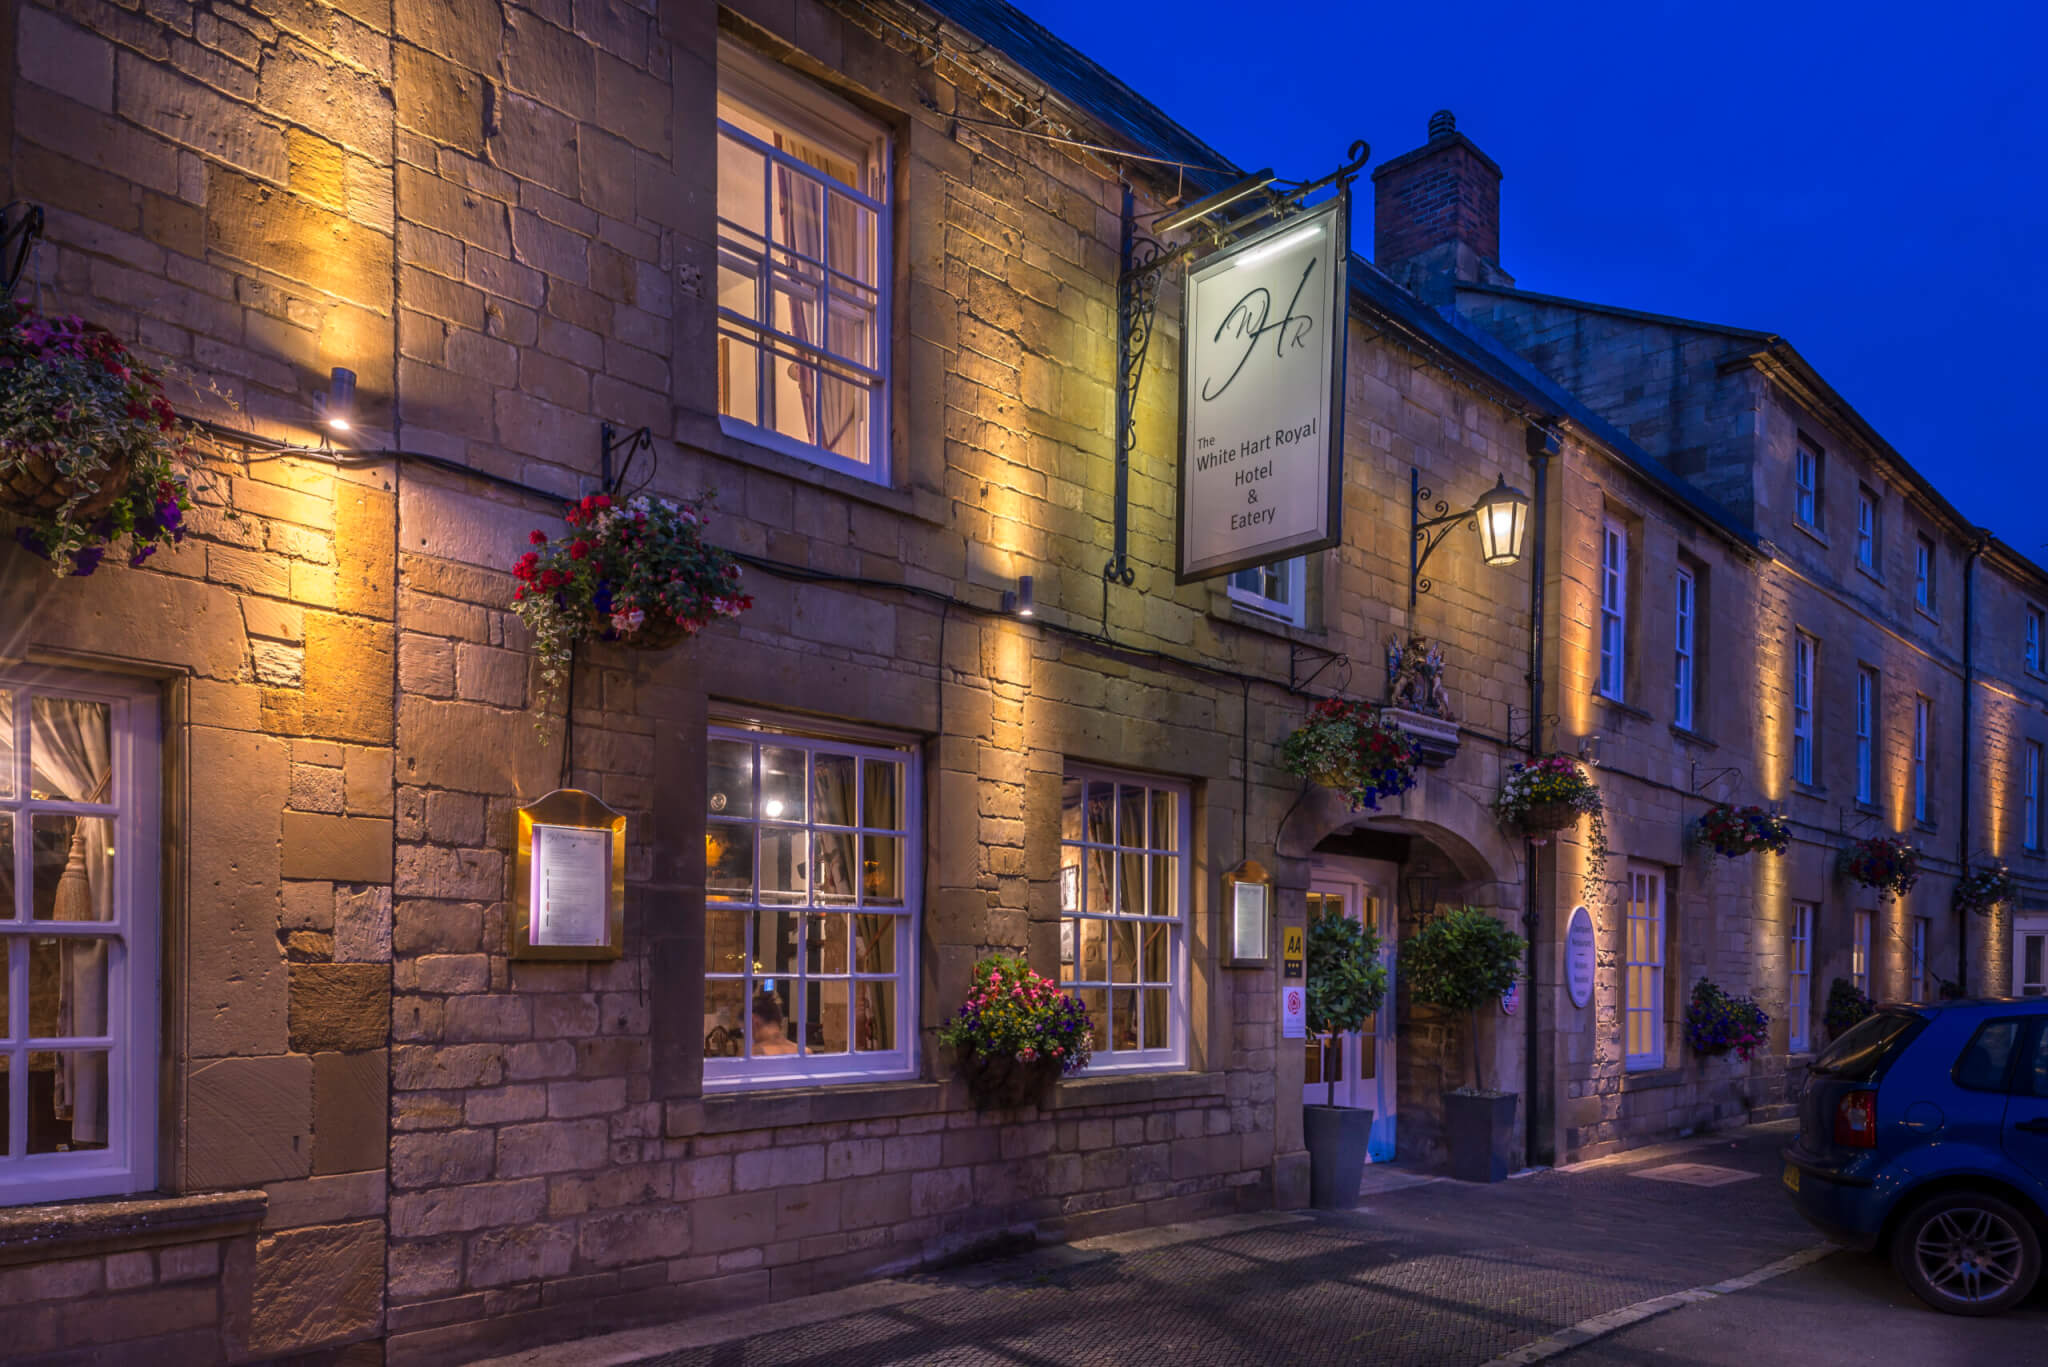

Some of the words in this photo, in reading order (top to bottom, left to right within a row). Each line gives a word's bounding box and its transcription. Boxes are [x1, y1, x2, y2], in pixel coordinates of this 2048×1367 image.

[1196, 448, 1236, 473] White
[1240, 434, 1271, 459] Hart
[1275, 417, 1316, 448] Royal
[1198, 436, 1216, 450] The
[1234, 459, 1273, 488] Hotel
[1247, 488, 1258, 505] &
[1230, 507, 1276, 531] Eatery
[1287, 935, 1302, 954] AA
